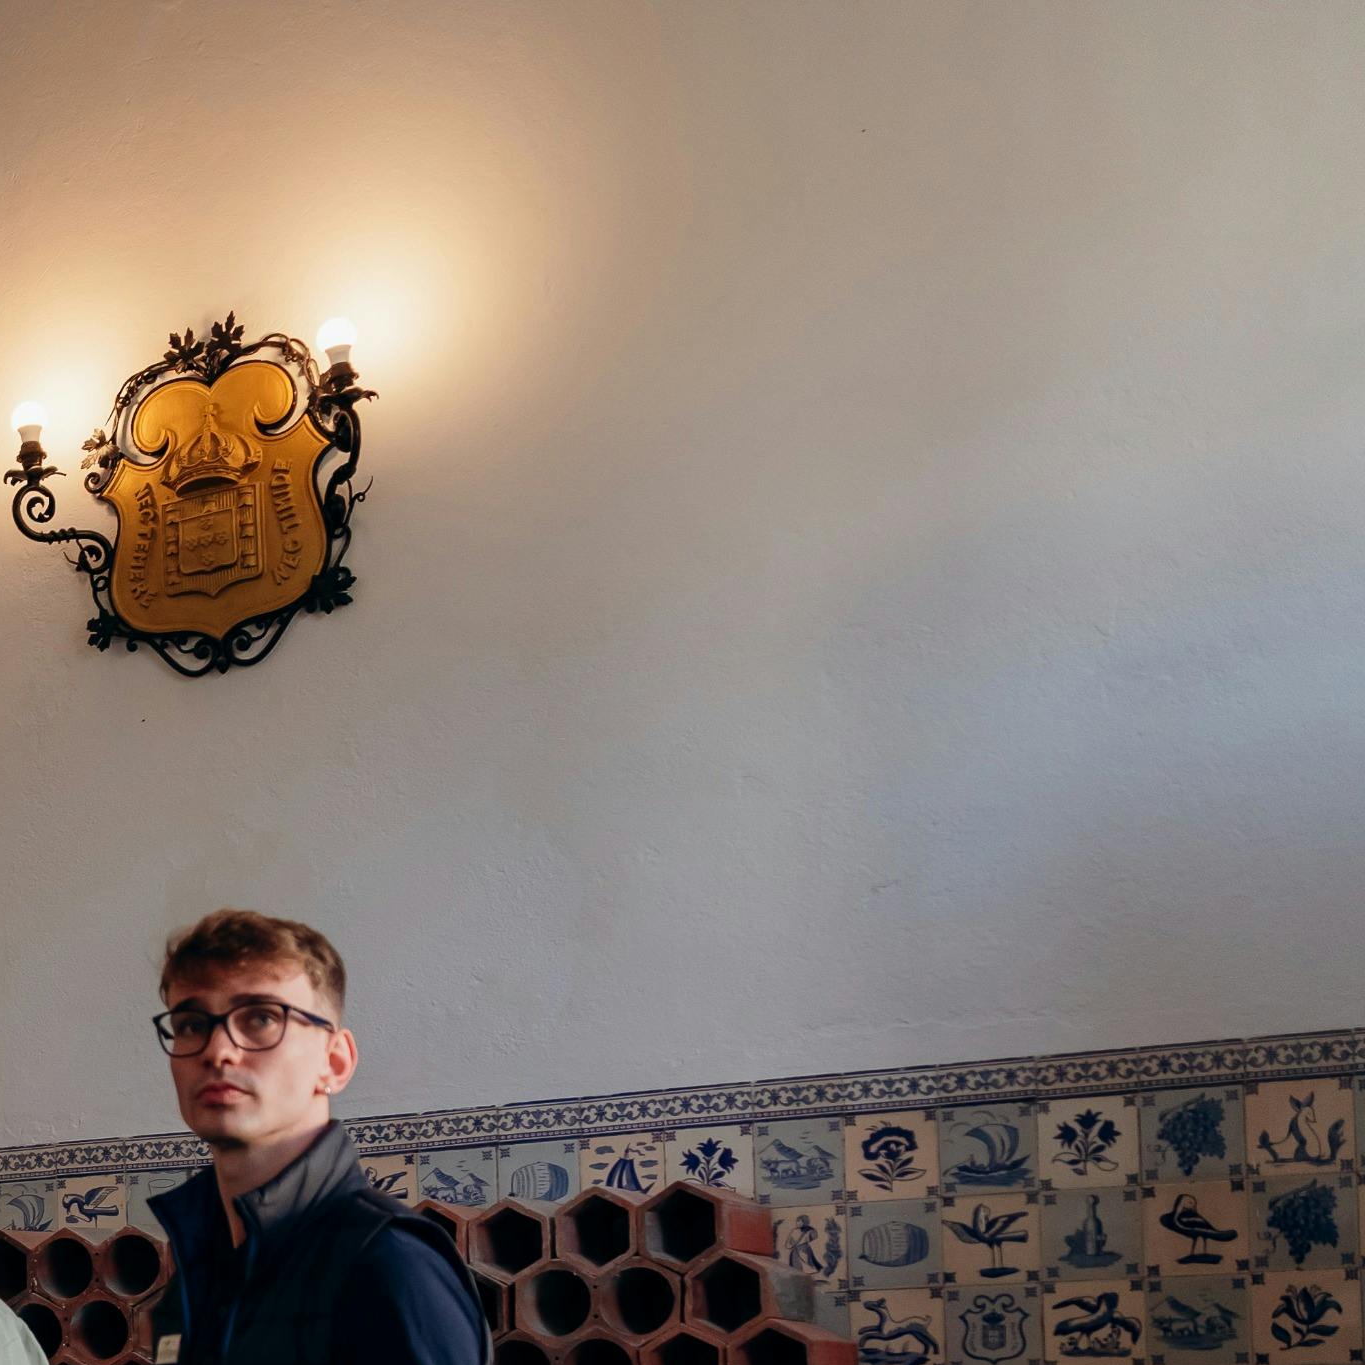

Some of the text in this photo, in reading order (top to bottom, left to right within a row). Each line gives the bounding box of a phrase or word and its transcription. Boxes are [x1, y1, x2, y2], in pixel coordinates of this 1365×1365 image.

[129, 483, 160, 609] NEC TEMERE
[270, 459, 303, 586] NEC TIMIDE
